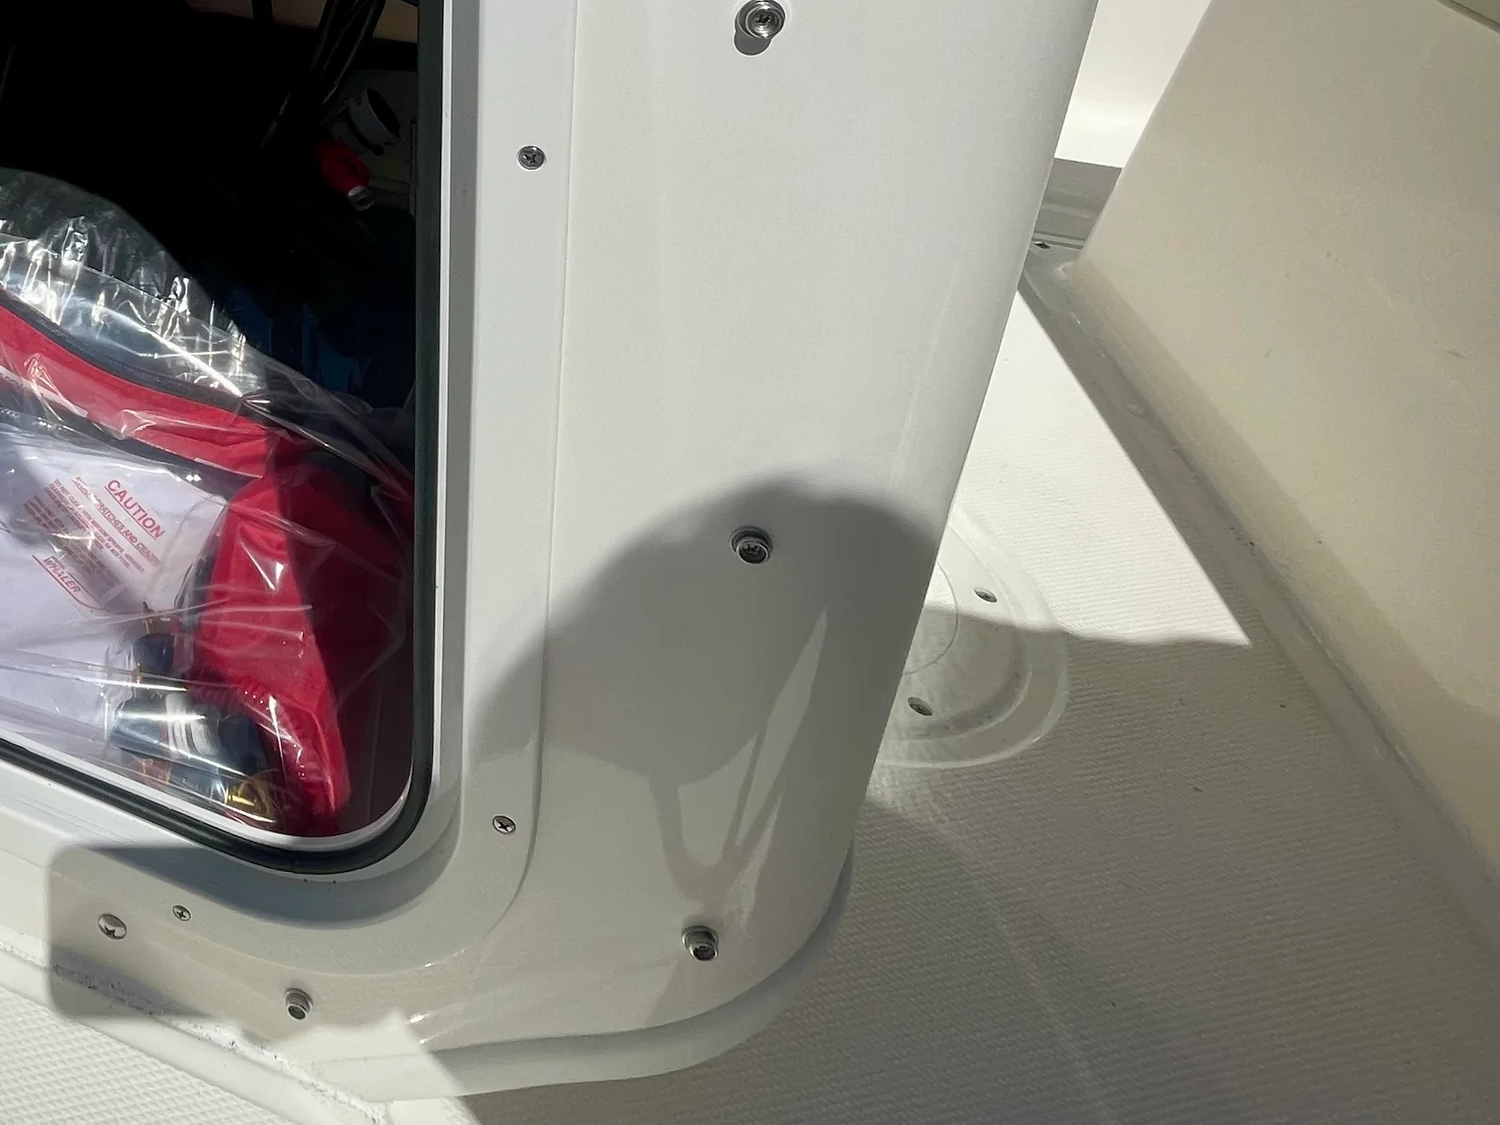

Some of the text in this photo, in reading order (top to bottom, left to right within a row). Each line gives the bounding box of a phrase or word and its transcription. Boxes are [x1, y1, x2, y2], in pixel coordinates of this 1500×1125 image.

[108, 480, 165, 539] CAUTION
[122, 529, 138, 544] AND
[43, 558, 81, 593] WHALER
